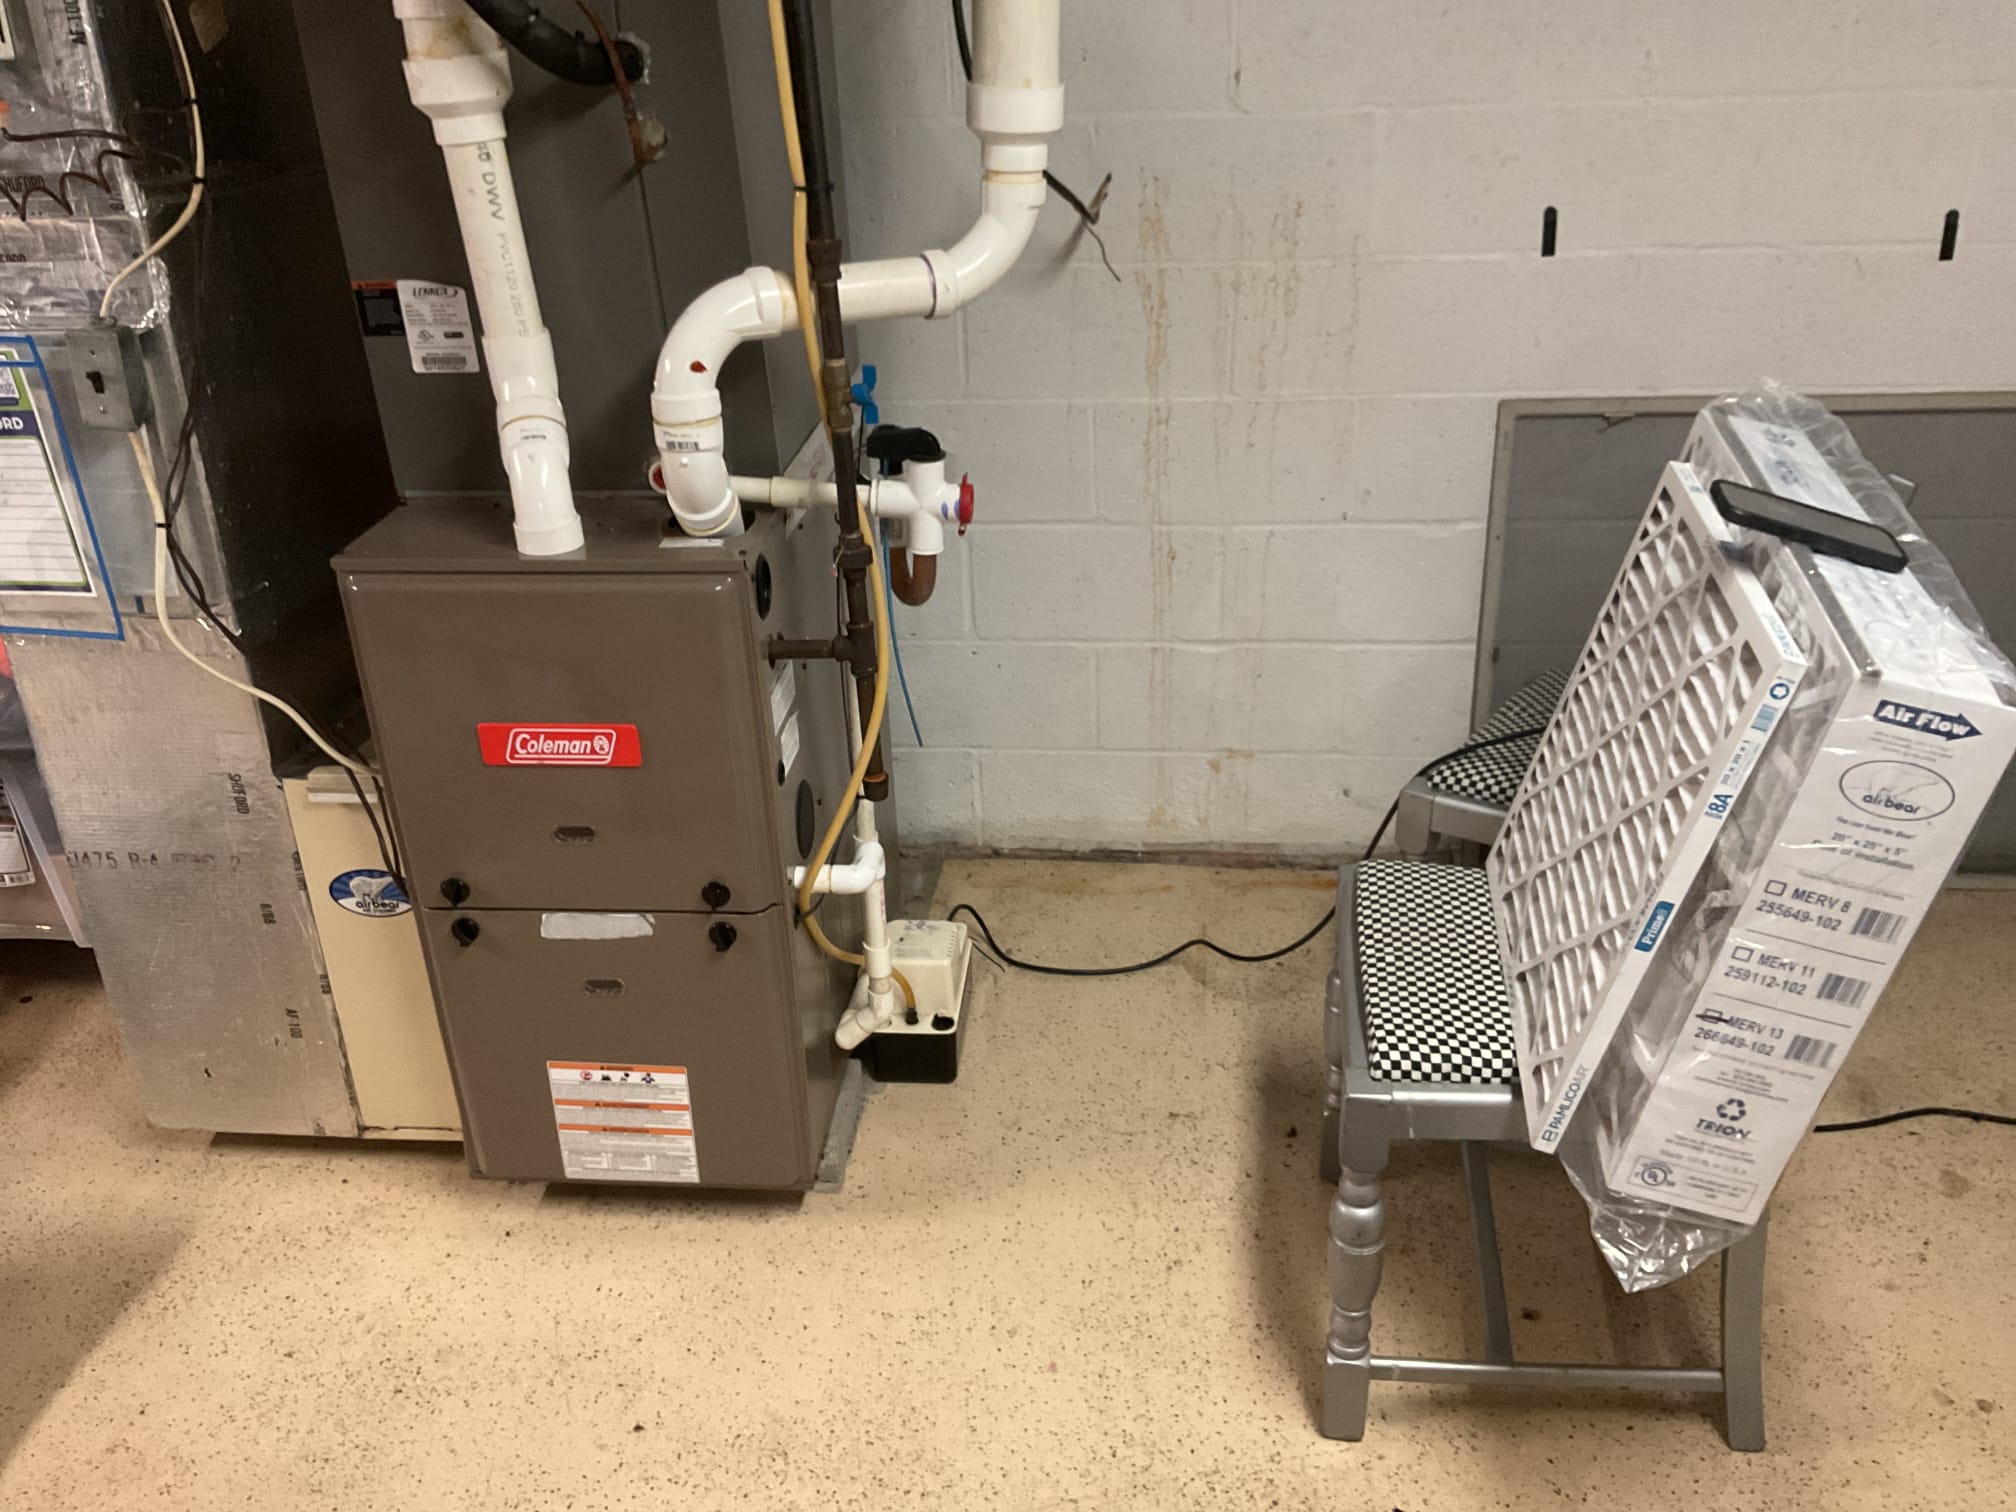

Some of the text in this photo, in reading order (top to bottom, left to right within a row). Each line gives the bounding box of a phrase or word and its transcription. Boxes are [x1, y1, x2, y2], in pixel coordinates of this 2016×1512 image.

[481, 171, 505, 221] DWV
[1878, 704, 1972, 736] Air Flow
[515, 733, 592, 755] Coleman
[228, 773, 250, 815] SHUFORD
[1708, 794, 1734, 814] 8A
[1791, 887, 1853, 914] MERV 8
[1755, 899, 1843, 931] 255649-102
[1723, 964, 1808, 995] 259112-102
[1800, 964, 1816, 979] 11
[1728, 1015, 1768, 1035] MERV
[1696, 1117, 1752, 1138] TRION
